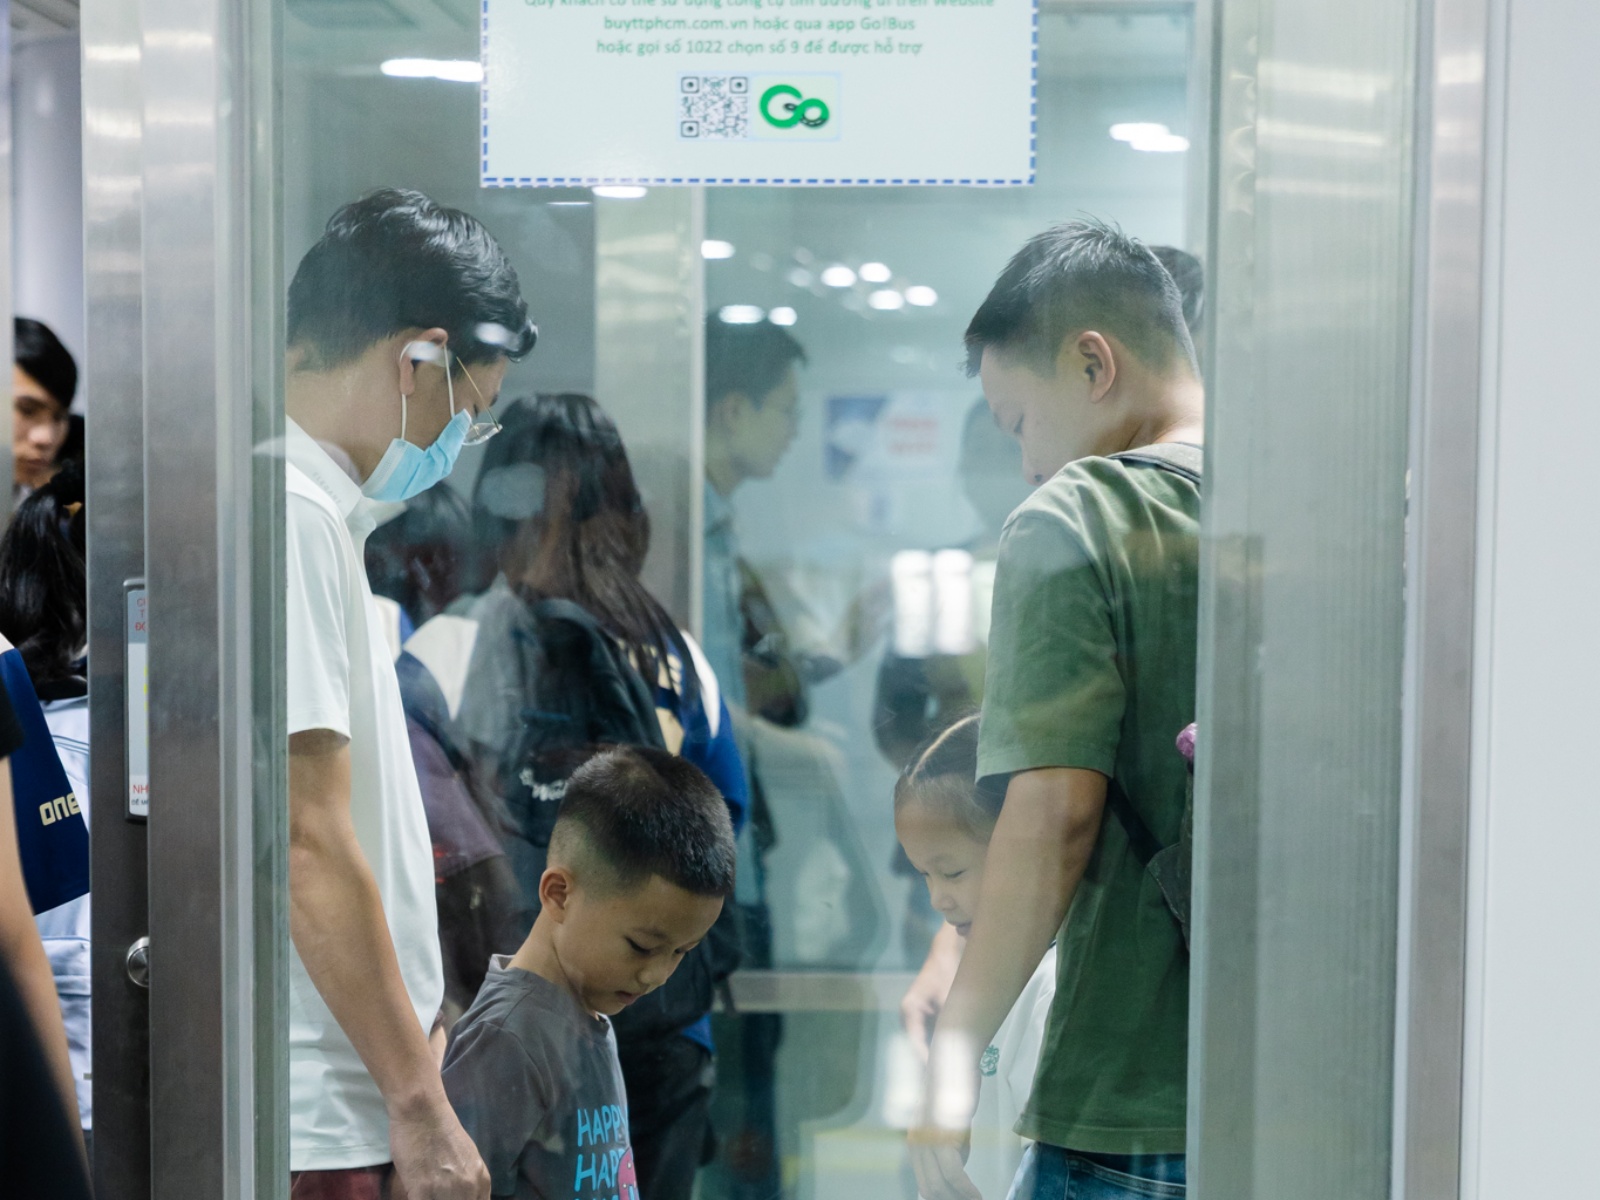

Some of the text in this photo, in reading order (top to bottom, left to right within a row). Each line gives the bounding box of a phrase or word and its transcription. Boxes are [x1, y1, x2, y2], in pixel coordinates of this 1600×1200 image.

[793, 19, 822, 32] qua
[827, 19, 855, 32] app
[686, 41, 722, 54] 1022
[790, 41, 799, 54] 9
